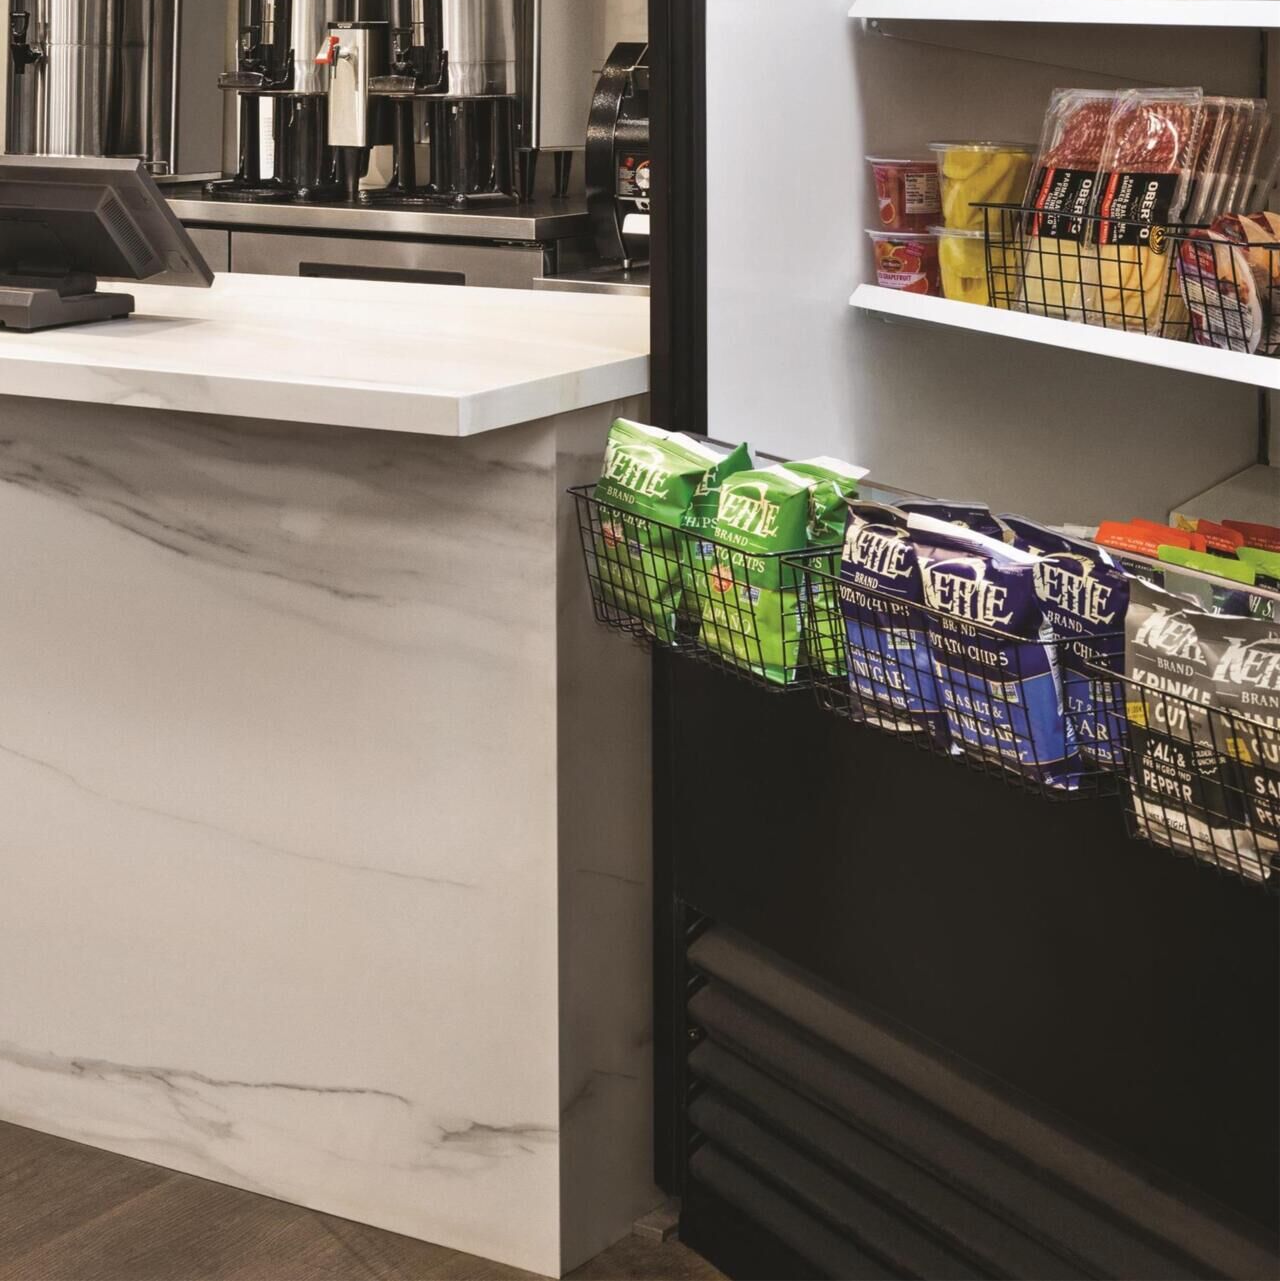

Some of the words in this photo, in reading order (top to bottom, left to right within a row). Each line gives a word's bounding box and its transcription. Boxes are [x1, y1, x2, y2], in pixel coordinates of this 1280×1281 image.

[606, 486, 636, 505] BRAND
[715, 527, 749, 546] BRAND
[854, 571, 878, 590] BRAND
[917, 556, 1014, 626] KETTLE
[1046, 609, 1083, 633] BRAND
[1157, 657, 1194, 677] BRAND
